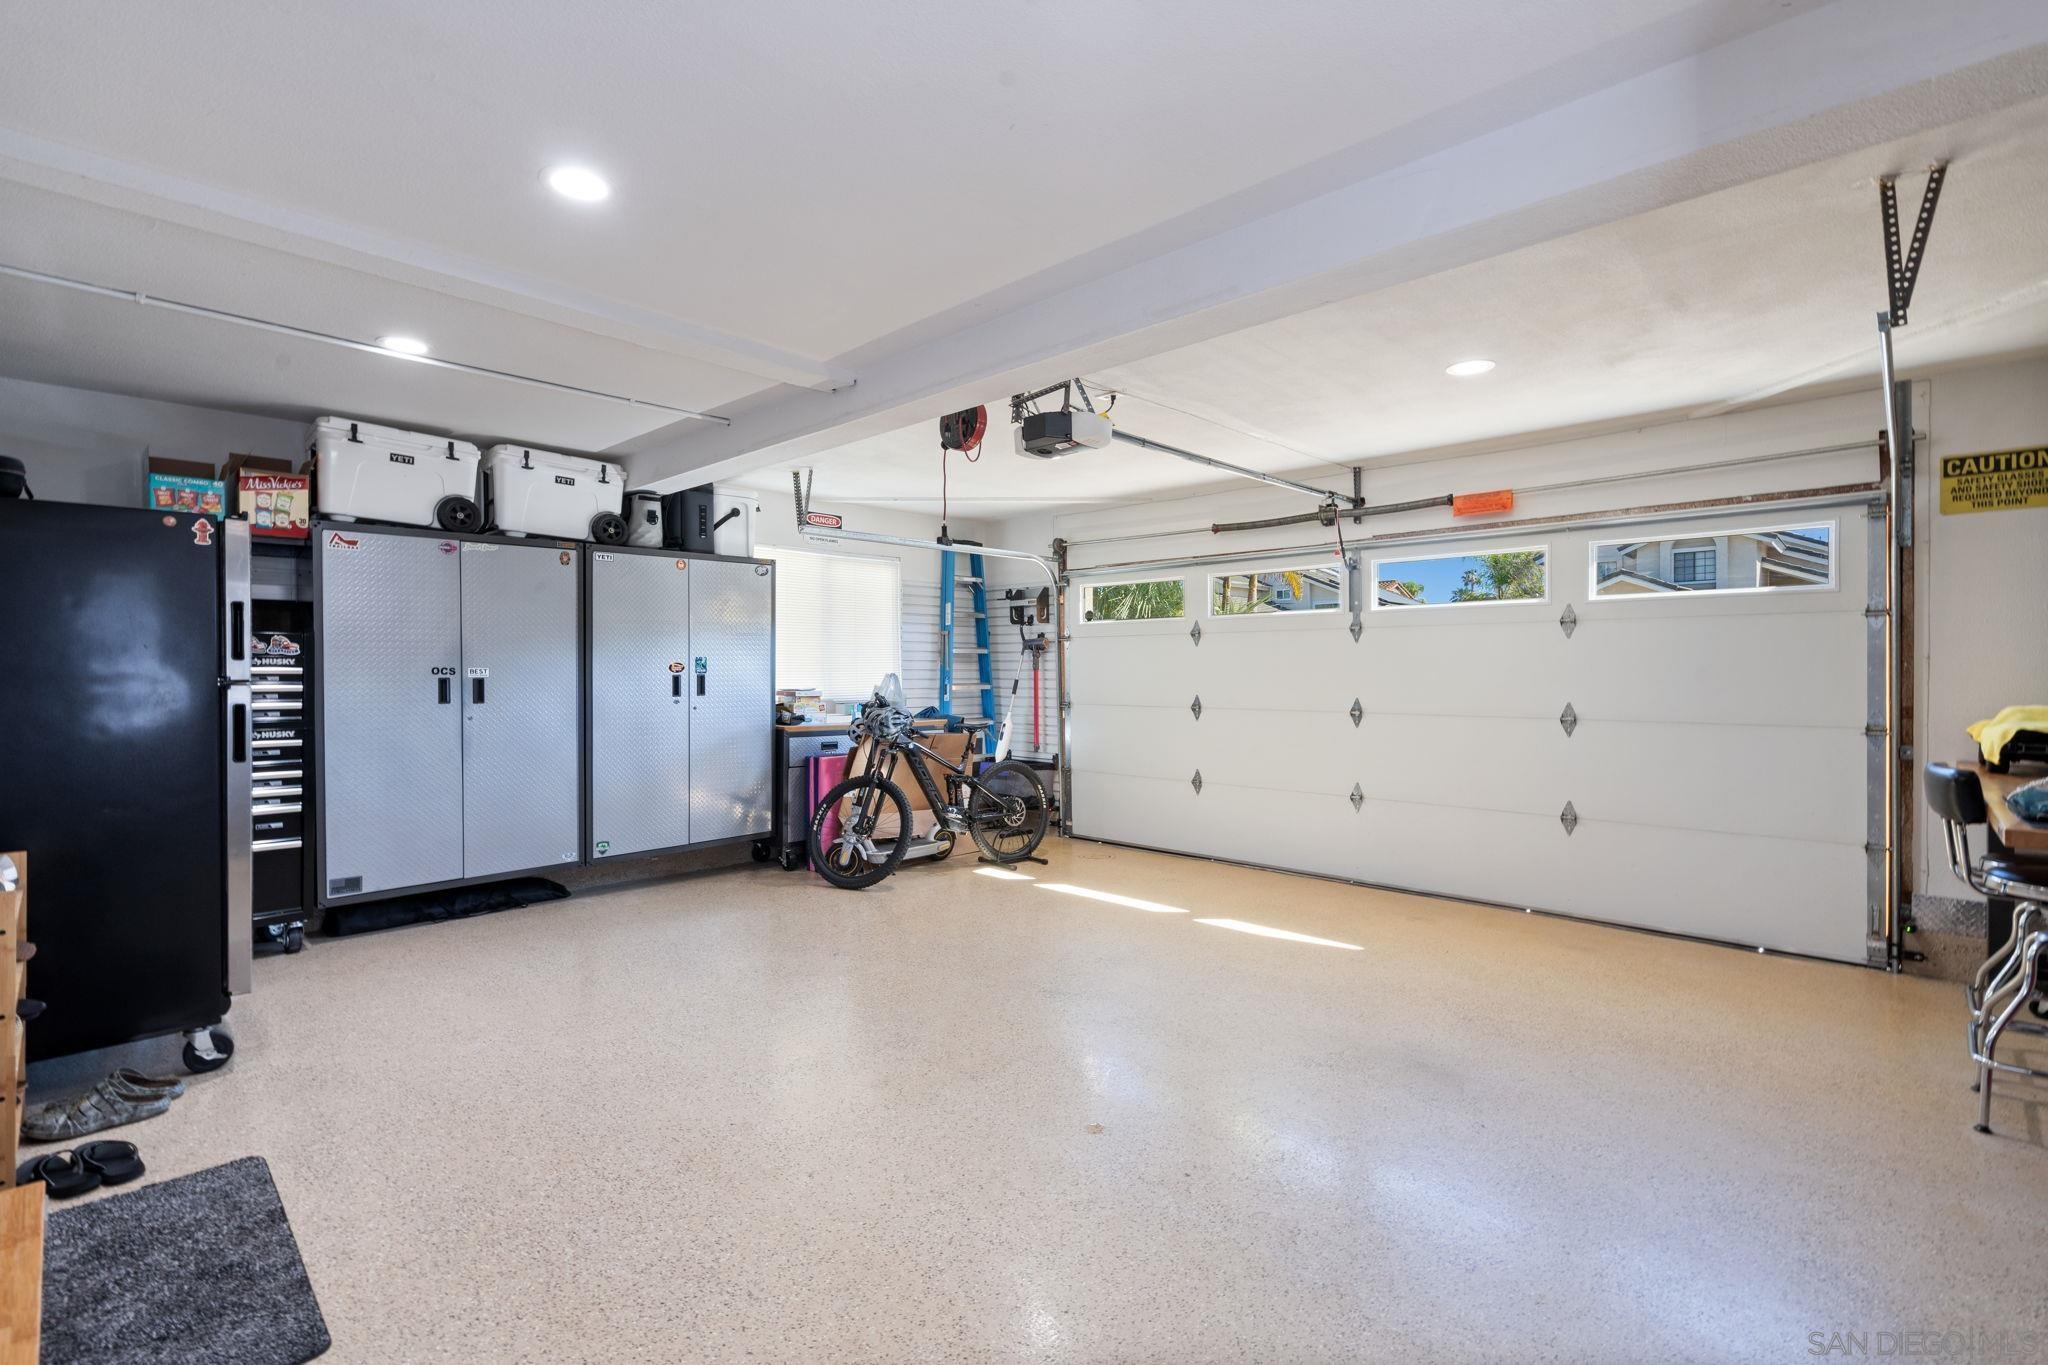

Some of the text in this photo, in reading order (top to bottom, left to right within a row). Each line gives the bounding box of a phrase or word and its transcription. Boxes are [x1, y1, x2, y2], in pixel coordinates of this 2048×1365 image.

[391, 454, 413, 464] YETI
[1947, 450, 2048, 476] CAUTION
[556, 476, 574, 486] YETI
[1957, 470, 2044, 486] SAFETY GLASSES
[1951, 486, 1972, 495] AND
[1976, 481, 2013, 492] SAFETY
[1952, 491, 2001, 502] REQUIRED
[1972, 497, 2028, 509] THIS POINT
[810, 515, 837, 525] DANGER
[261, 658, 296, 666] HUSKY
[431, 667, 456, 675] OCS
[261, 731, 296, 739] HUSKY
